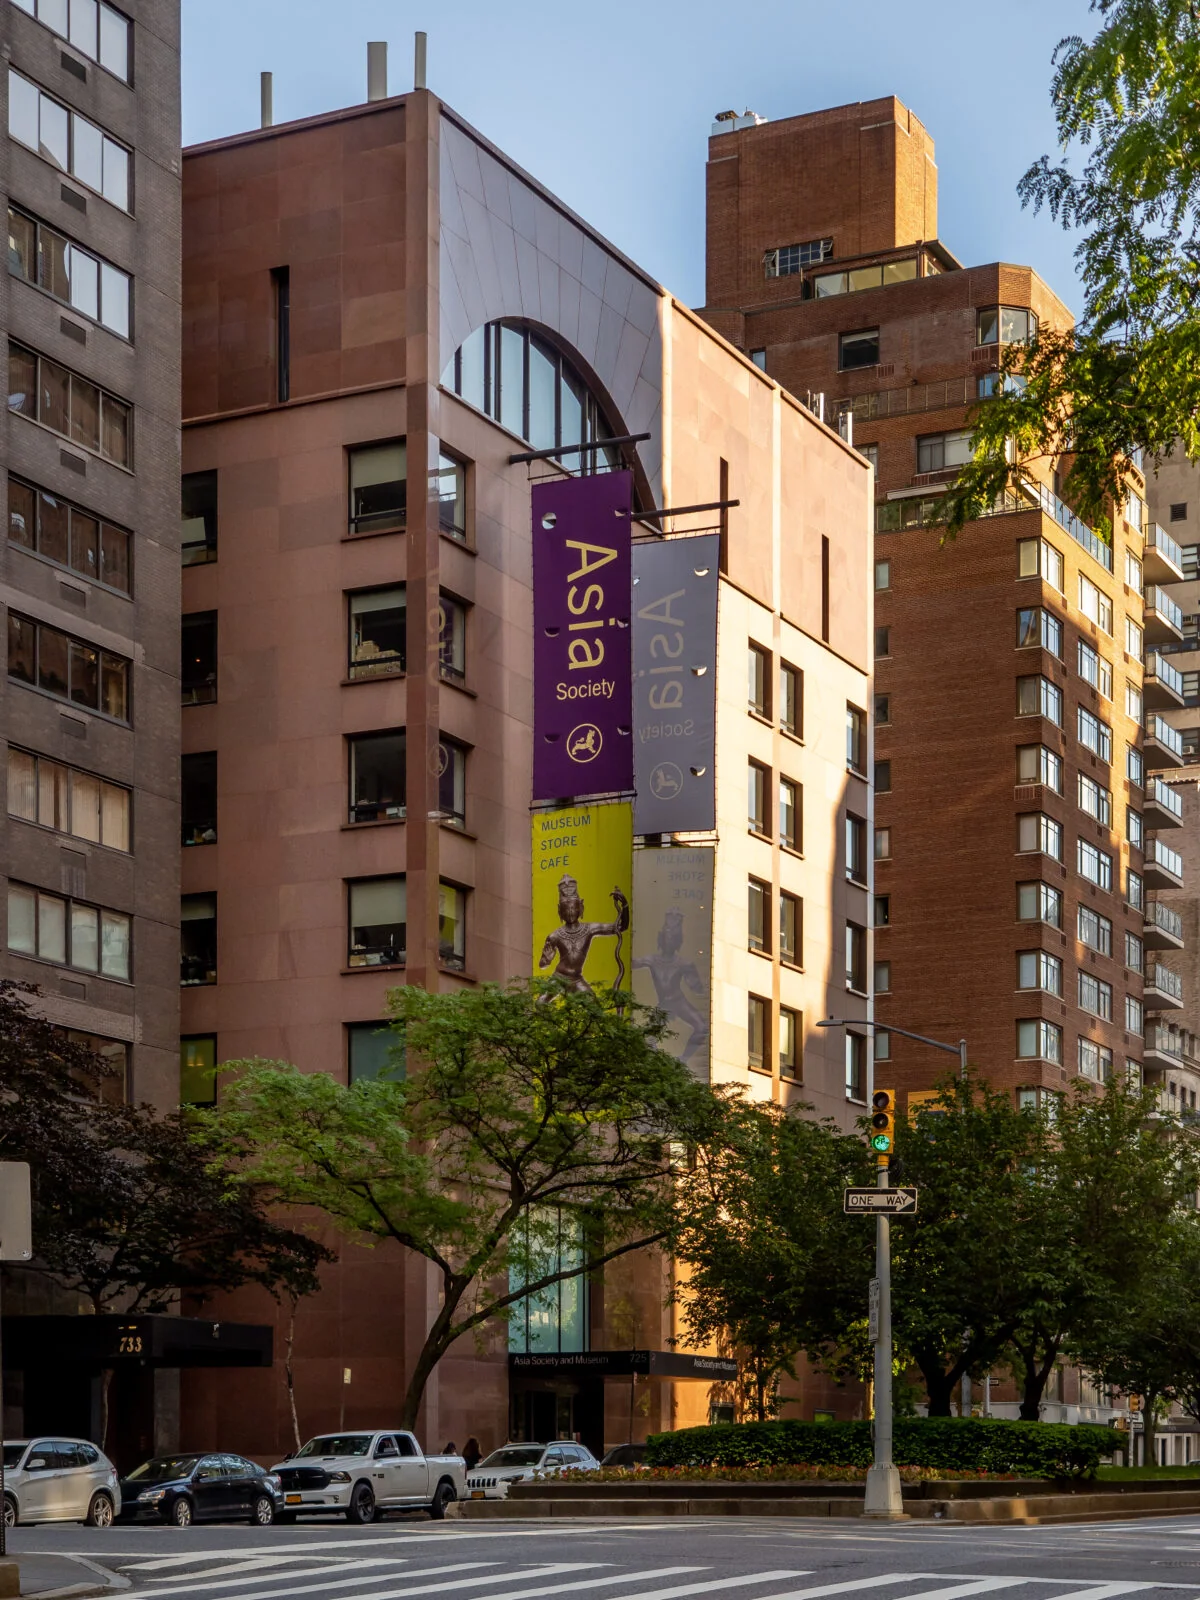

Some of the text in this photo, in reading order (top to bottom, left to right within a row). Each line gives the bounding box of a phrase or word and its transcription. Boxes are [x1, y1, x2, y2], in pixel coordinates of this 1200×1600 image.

[565, 539, 618, 670] Asia
[556, 679, 616, 701] Society
[541, 814, 591, 832] MUSEUM
[540, 835, 578, 851] STORE
[851, 1196, 909, 1205] ONE WAY
[120, 1336, 142, 1352] 733
[514, 1355, 608, 1367] Asia Society and Museum
[629, 1352, 647, 1363] 725
